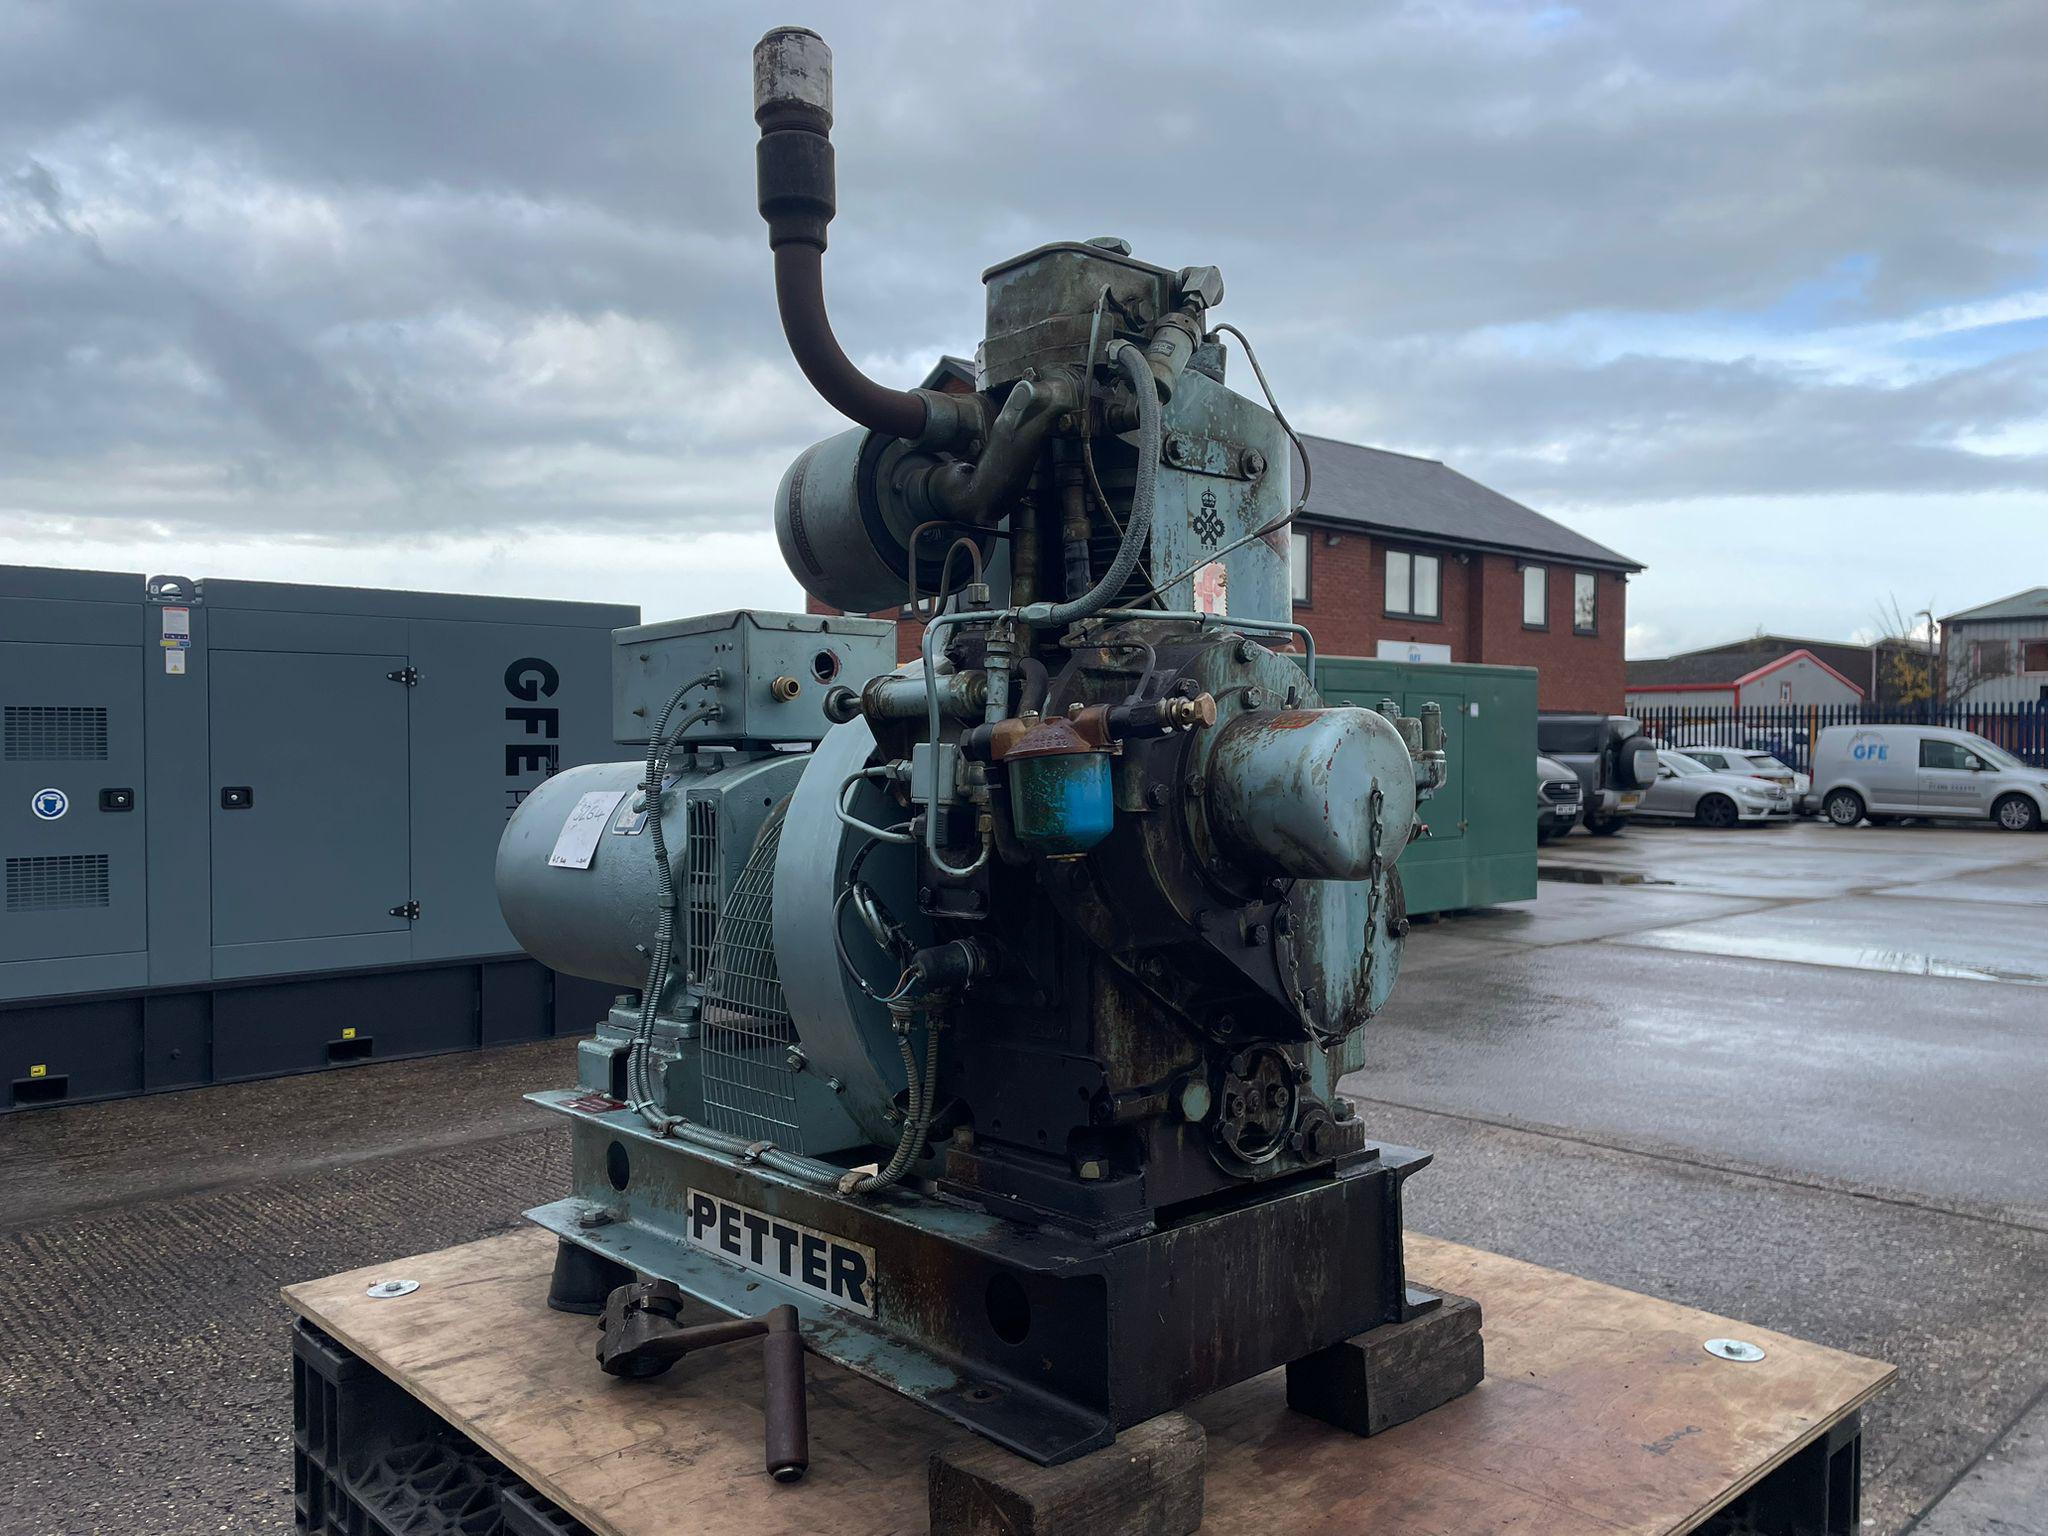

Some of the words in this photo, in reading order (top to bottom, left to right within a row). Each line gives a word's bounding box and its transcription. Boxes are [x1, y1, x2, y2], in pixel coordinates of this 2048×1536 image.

[504, 657, 560, 777] GFE
[1853, 744, 1889, 761] GFE
[693, 1193, 868, 1307] PETTER
